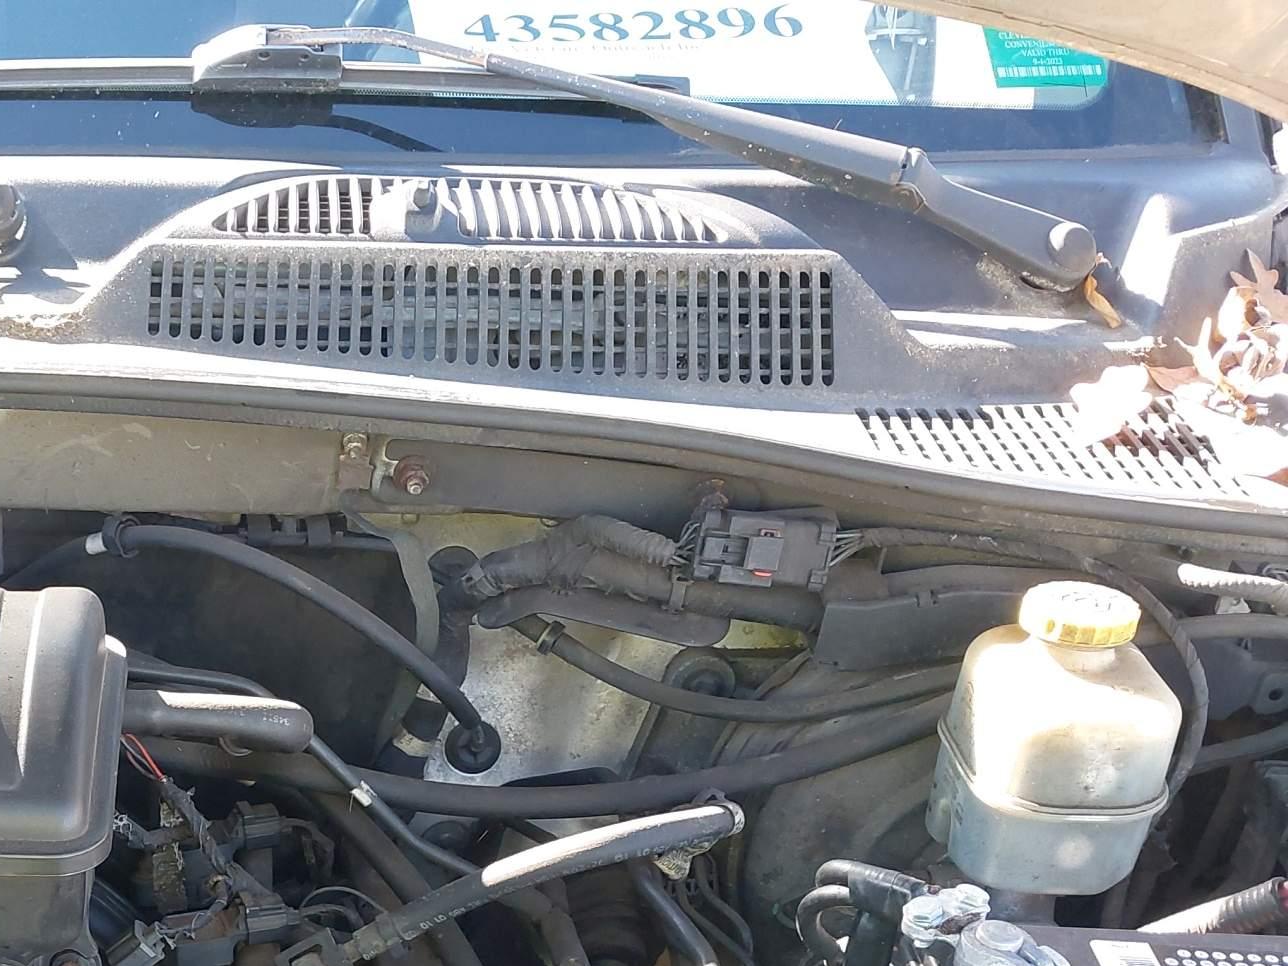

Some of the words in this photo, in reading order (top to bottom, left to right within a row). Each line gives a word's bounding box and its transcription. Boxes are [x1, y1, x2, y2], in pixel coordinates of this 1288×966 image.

[463, 4, 803, 42] 43582896
[1022, 48, 1046, 57] VALID
[1047, 47, 1070, 56] THRU
